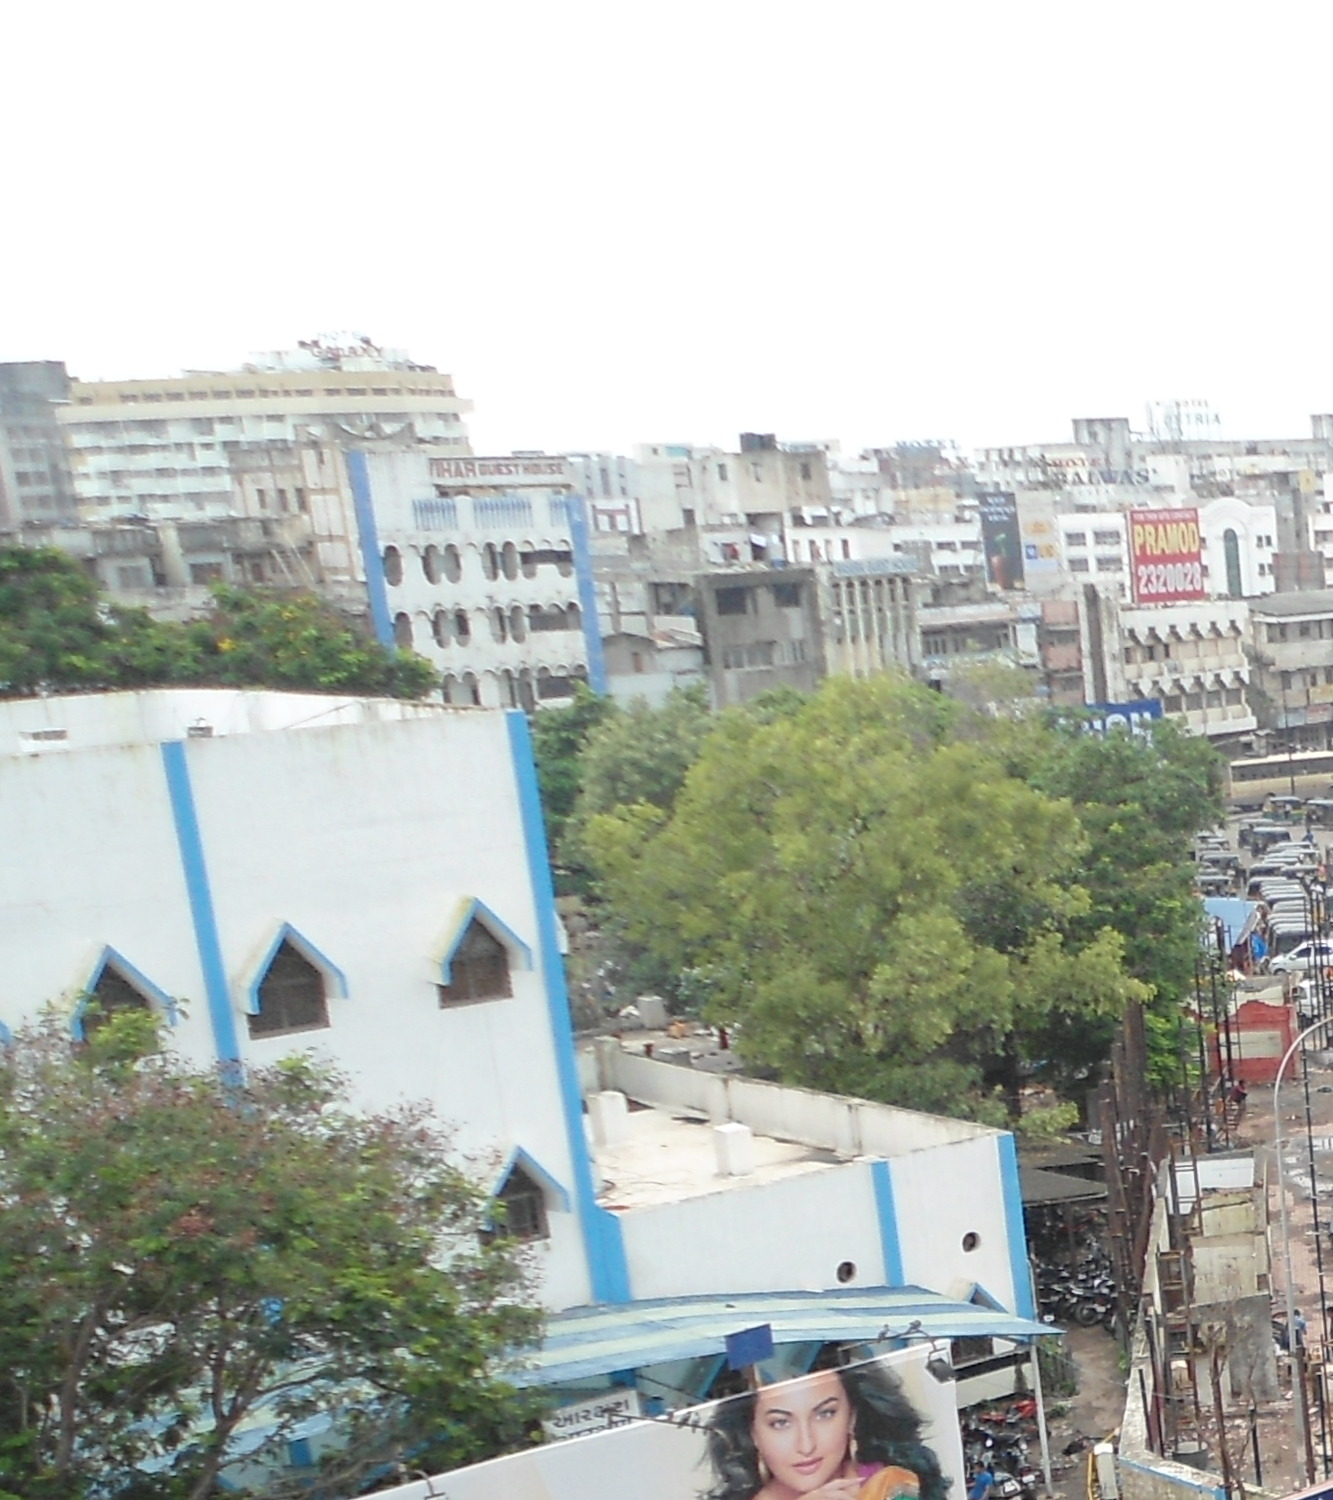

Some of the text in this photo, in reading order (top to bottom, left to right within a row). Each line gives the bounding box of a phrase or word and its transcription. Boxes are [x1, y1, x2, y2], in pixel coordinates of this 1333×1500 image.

[479, 462, 520, 476] GUEST
[523, 462, 564, 475] HOUSE
[1133, 521, 1199, 555] PRAMOD
[1137, 562, 1201, 595] 2320028
